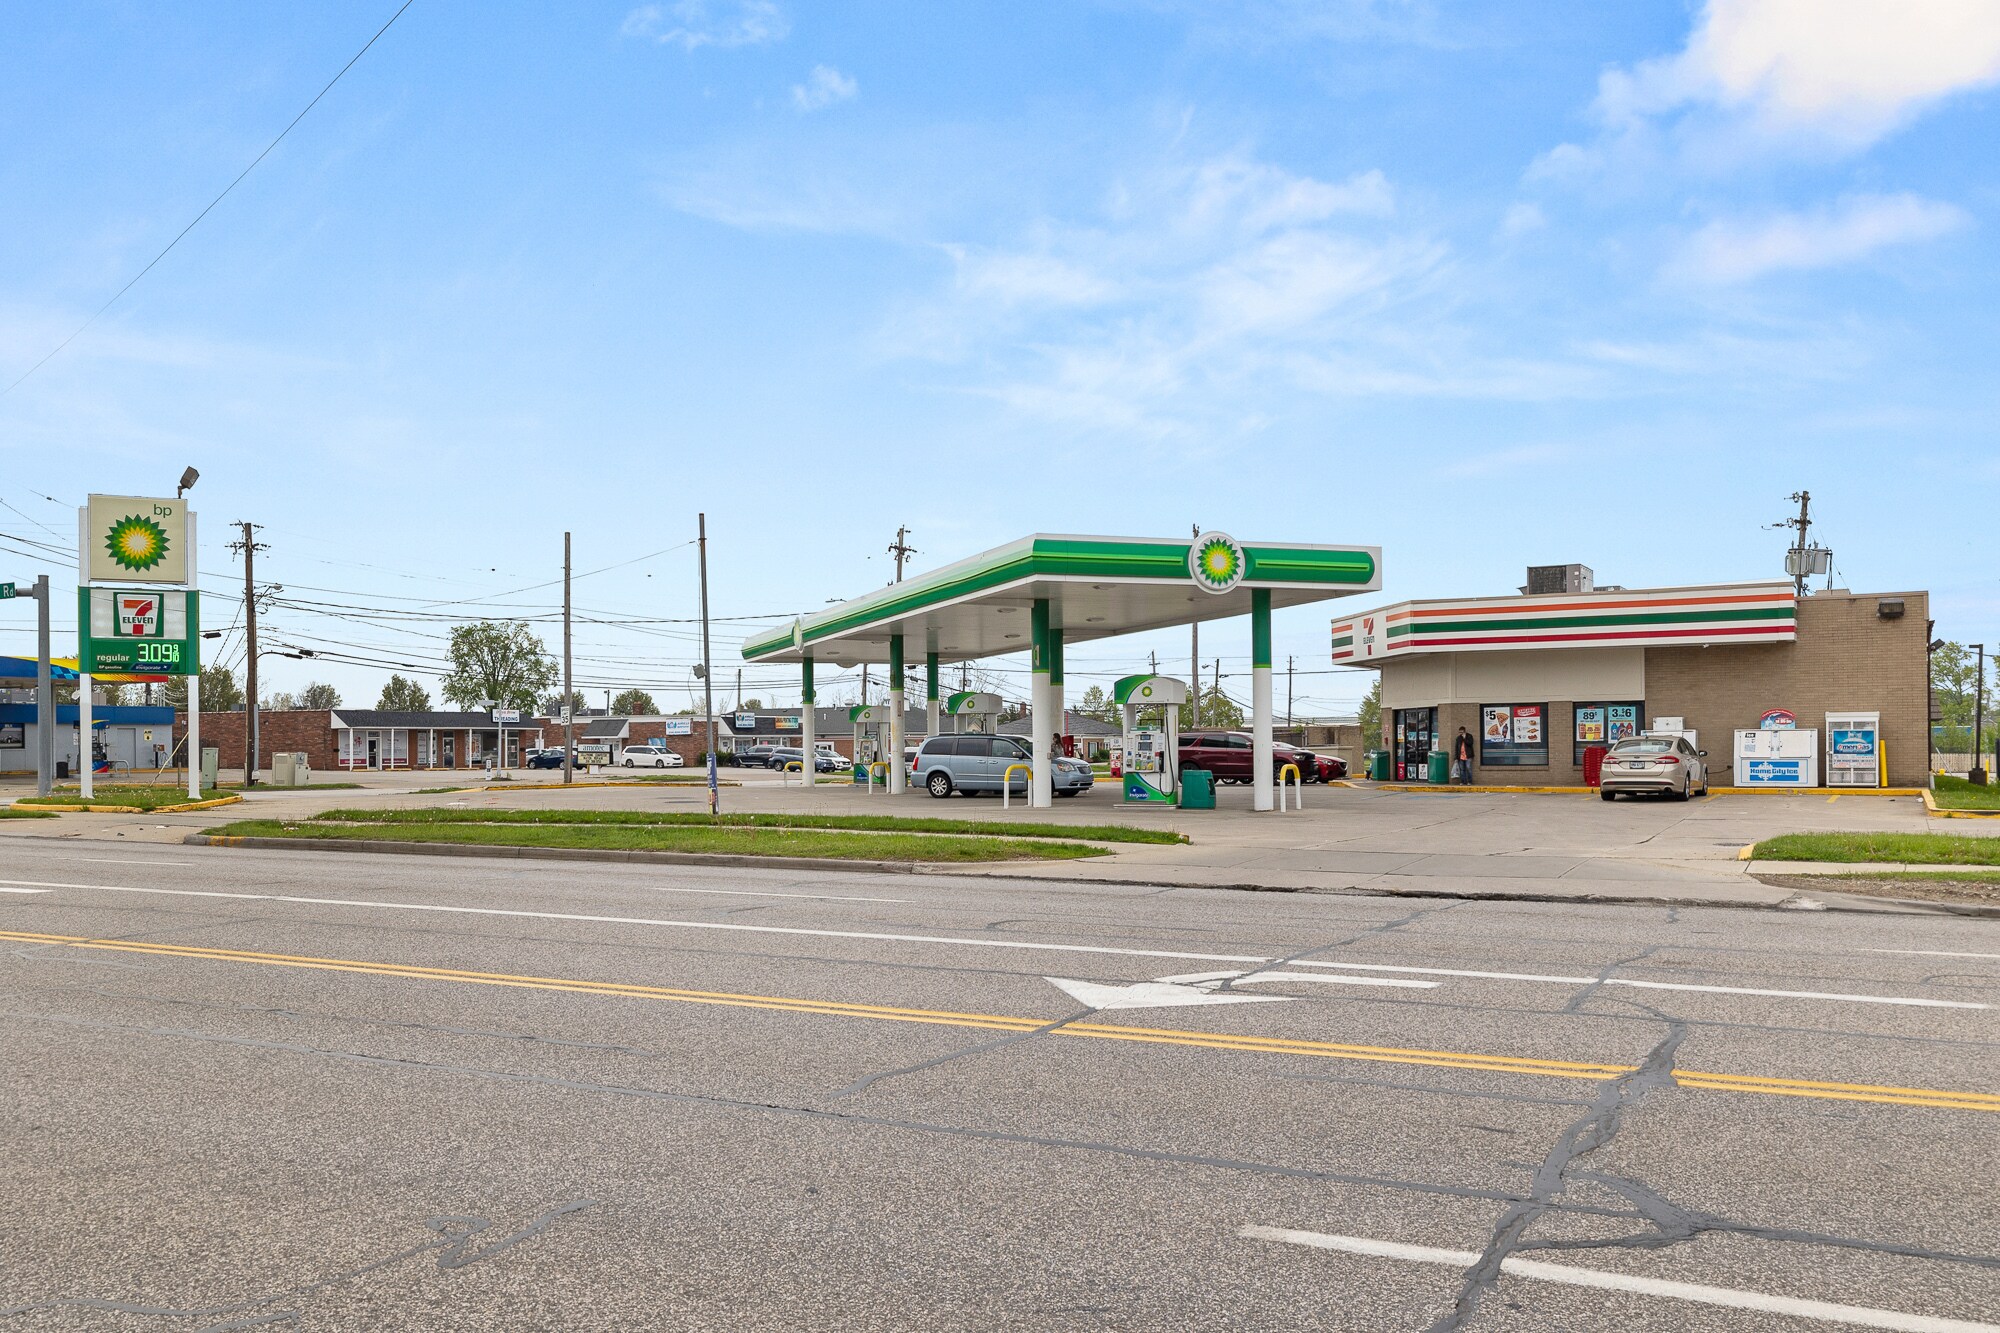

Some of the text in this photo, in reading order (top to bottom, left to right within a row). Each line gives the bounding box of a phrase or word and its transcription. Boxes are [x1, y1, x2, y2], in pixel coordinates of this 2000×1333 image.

[153, 503, 172, 519] bp
[3, 585, 14, 597] Rd
[123, 599, 153, 635] 7
[1363, 617, 1374, 656] 7
[96, 653, 130, 663] regular
[137, 643, 173, 662] 3.09
[1485, 710, 1497, 721] $5
[1611, 708, 1619, 718] 3
[561, 715, 569, 724] 35
[1772, 768, 1786, 776] City
